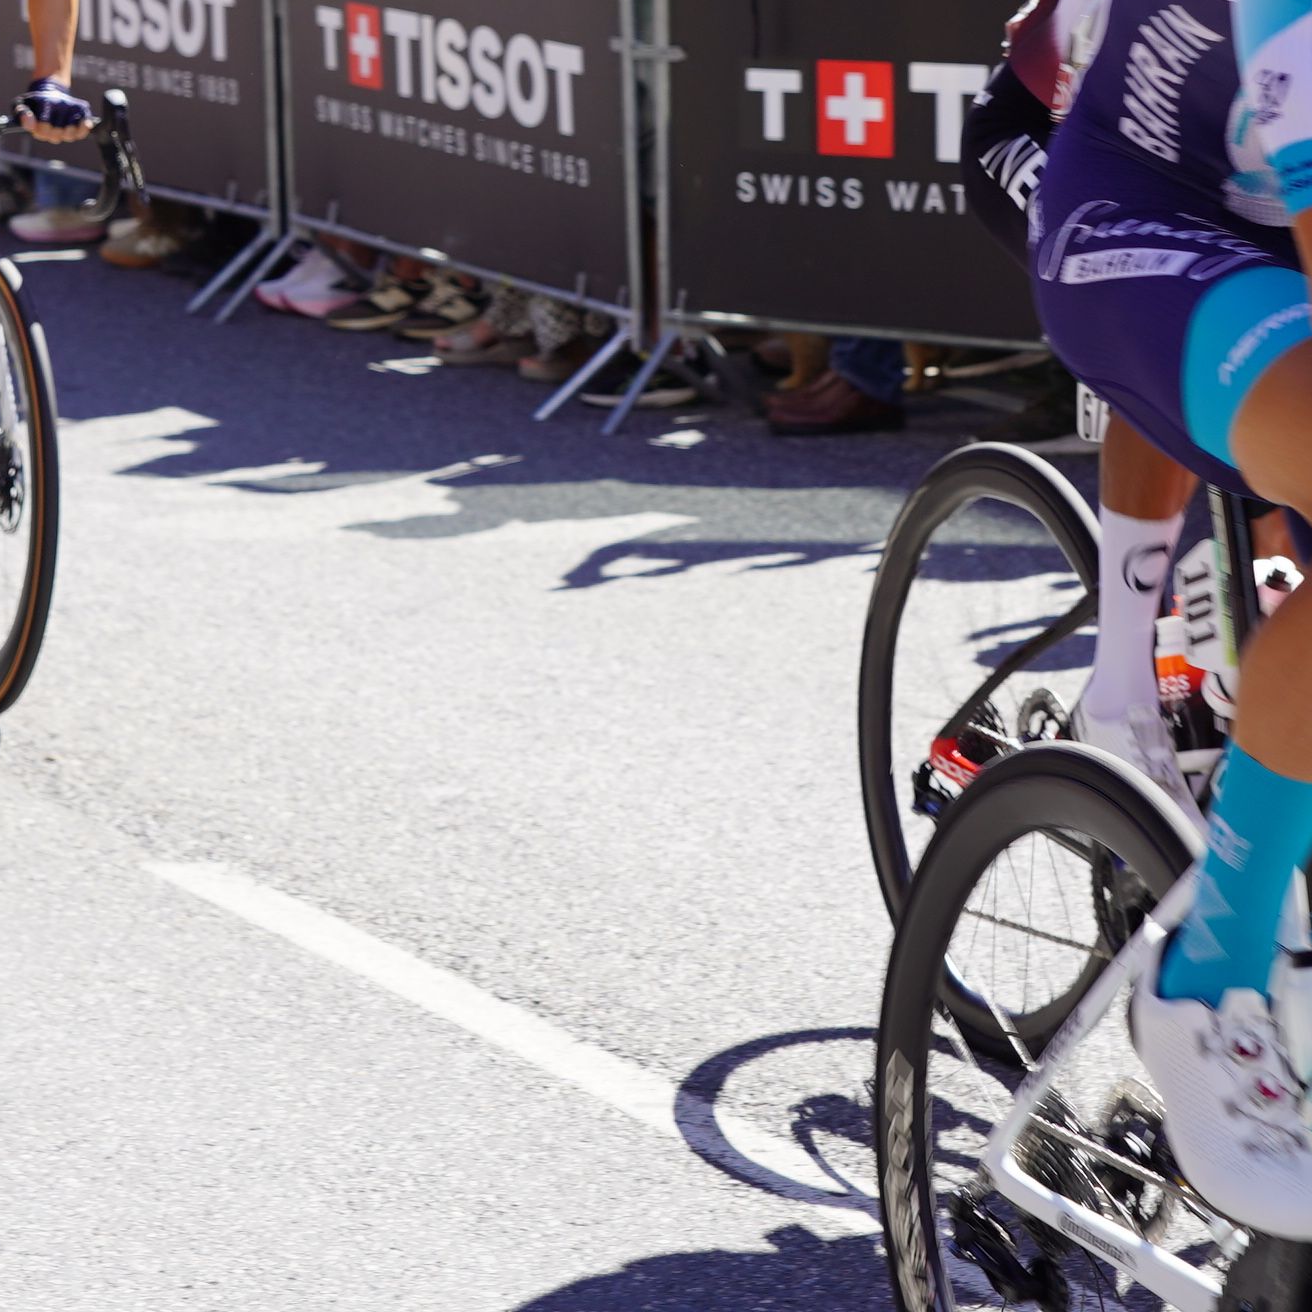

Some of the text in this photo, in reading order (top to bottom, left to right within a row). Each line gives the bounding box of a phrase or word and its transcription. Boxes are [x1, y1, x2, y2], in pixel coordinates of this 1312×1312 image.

[385, 6, 584, 137] TISSOT
[1117, 2, 1226, 163] BAHRAIN
[315, 95, 591, 188] SWISS WATCHES SINCE 1853
[736, 171, 865, 210] SWISS
[1184, 561, 1217, 647] 101
